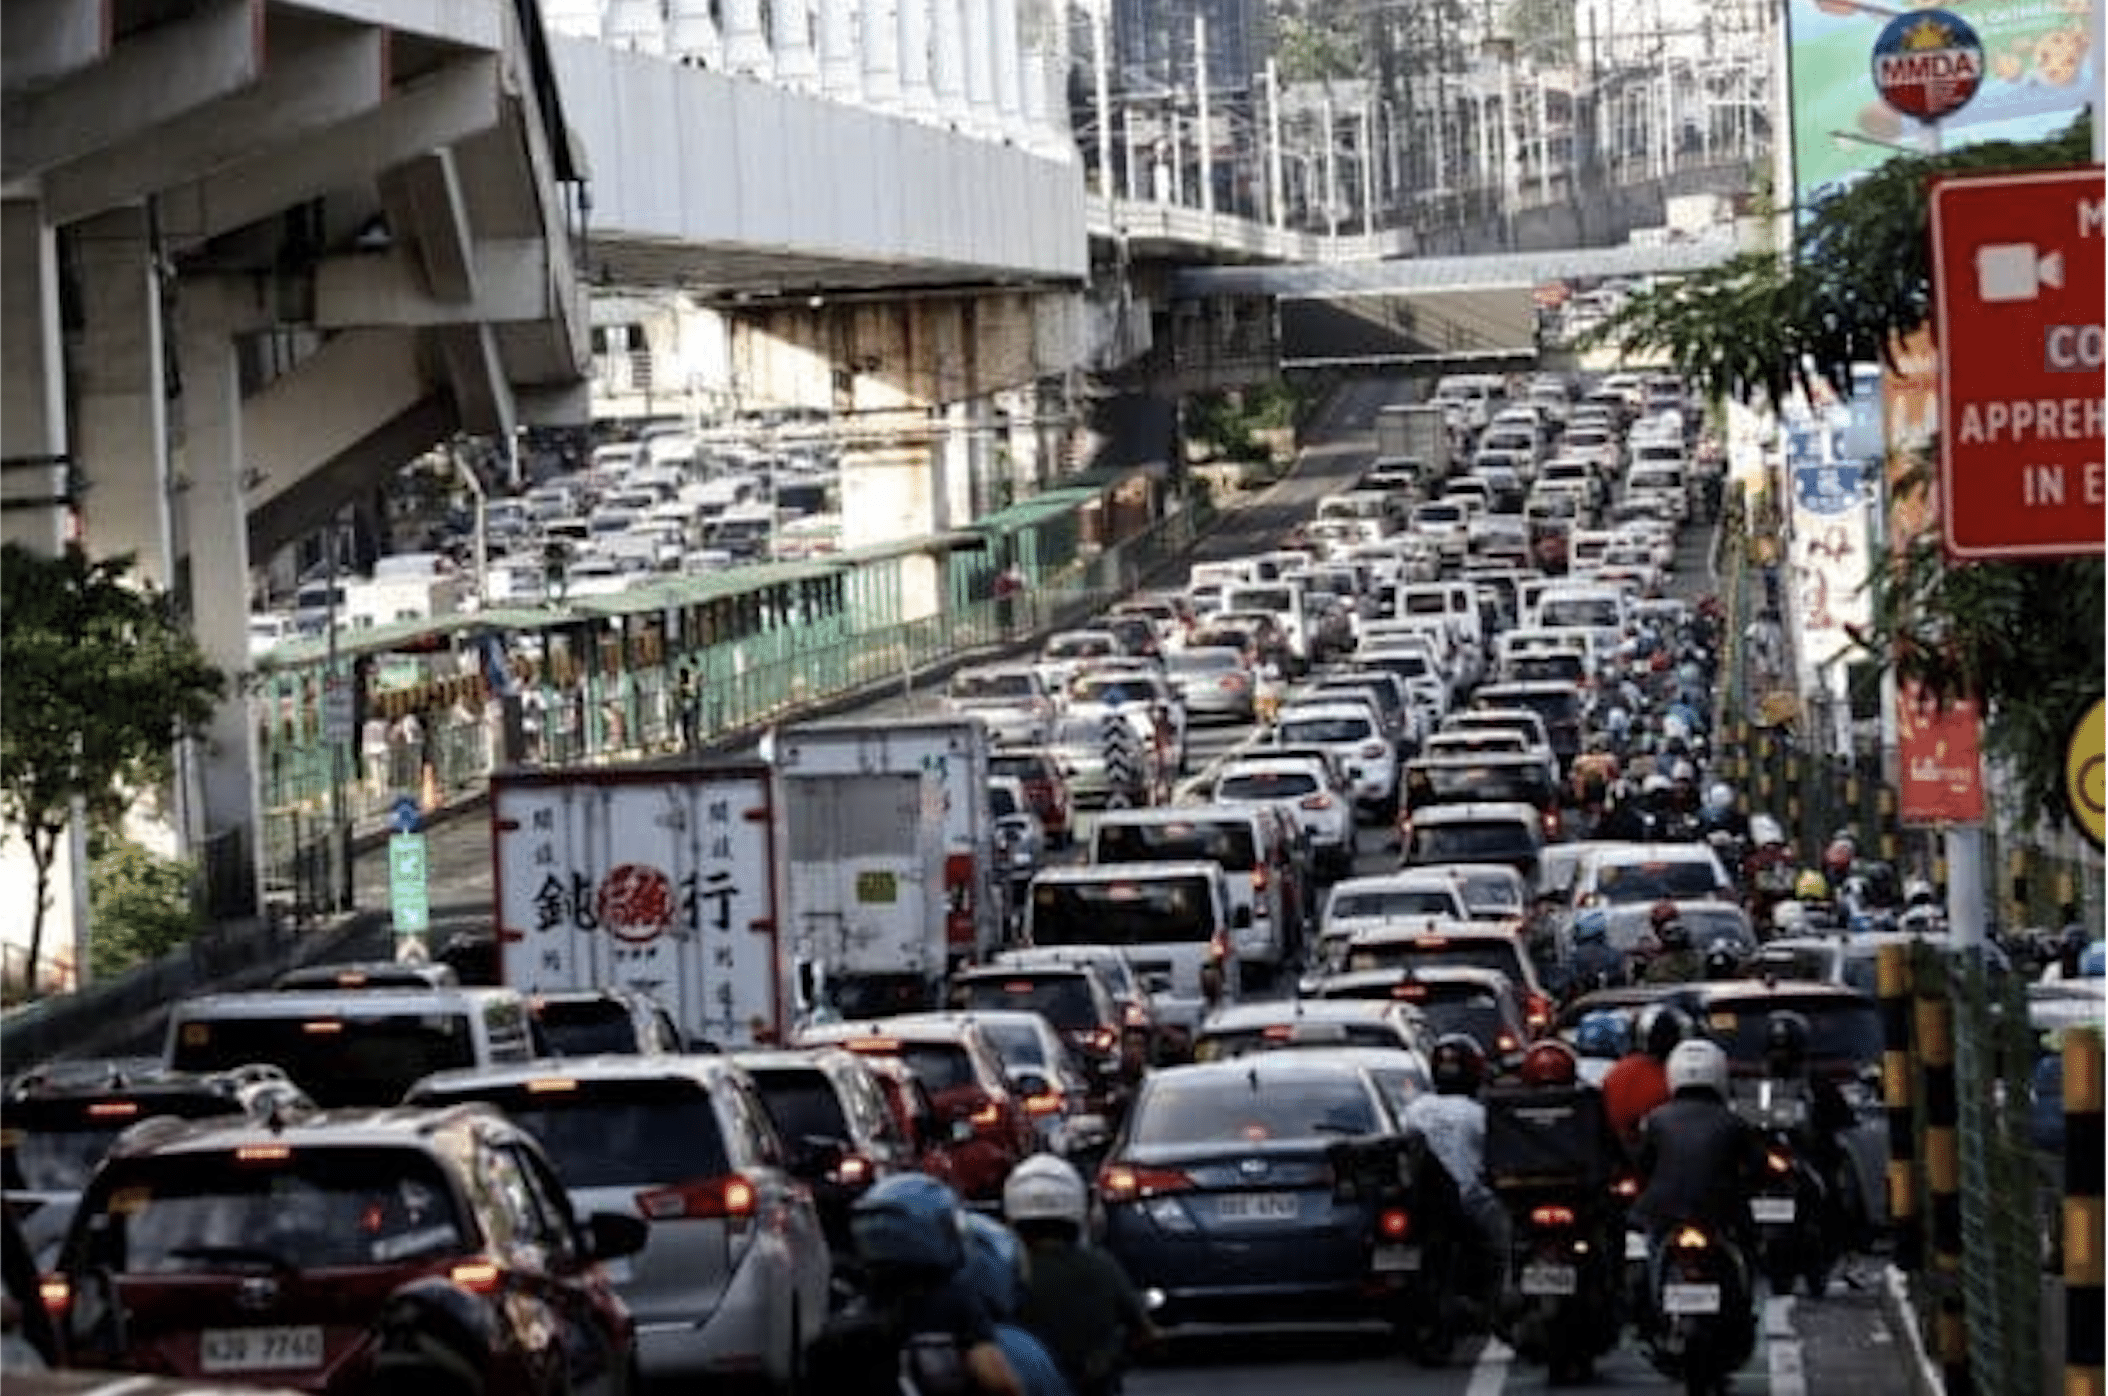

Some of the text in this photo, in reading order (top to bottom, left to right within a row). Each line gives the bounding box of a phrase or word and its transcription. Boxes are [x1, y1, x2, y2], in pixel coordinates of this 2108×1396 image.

[1880, 52, 1975, 83] MMDA
[2049, 325, 2106, 367] CO
[2023, 463, 2065, 506] IN
